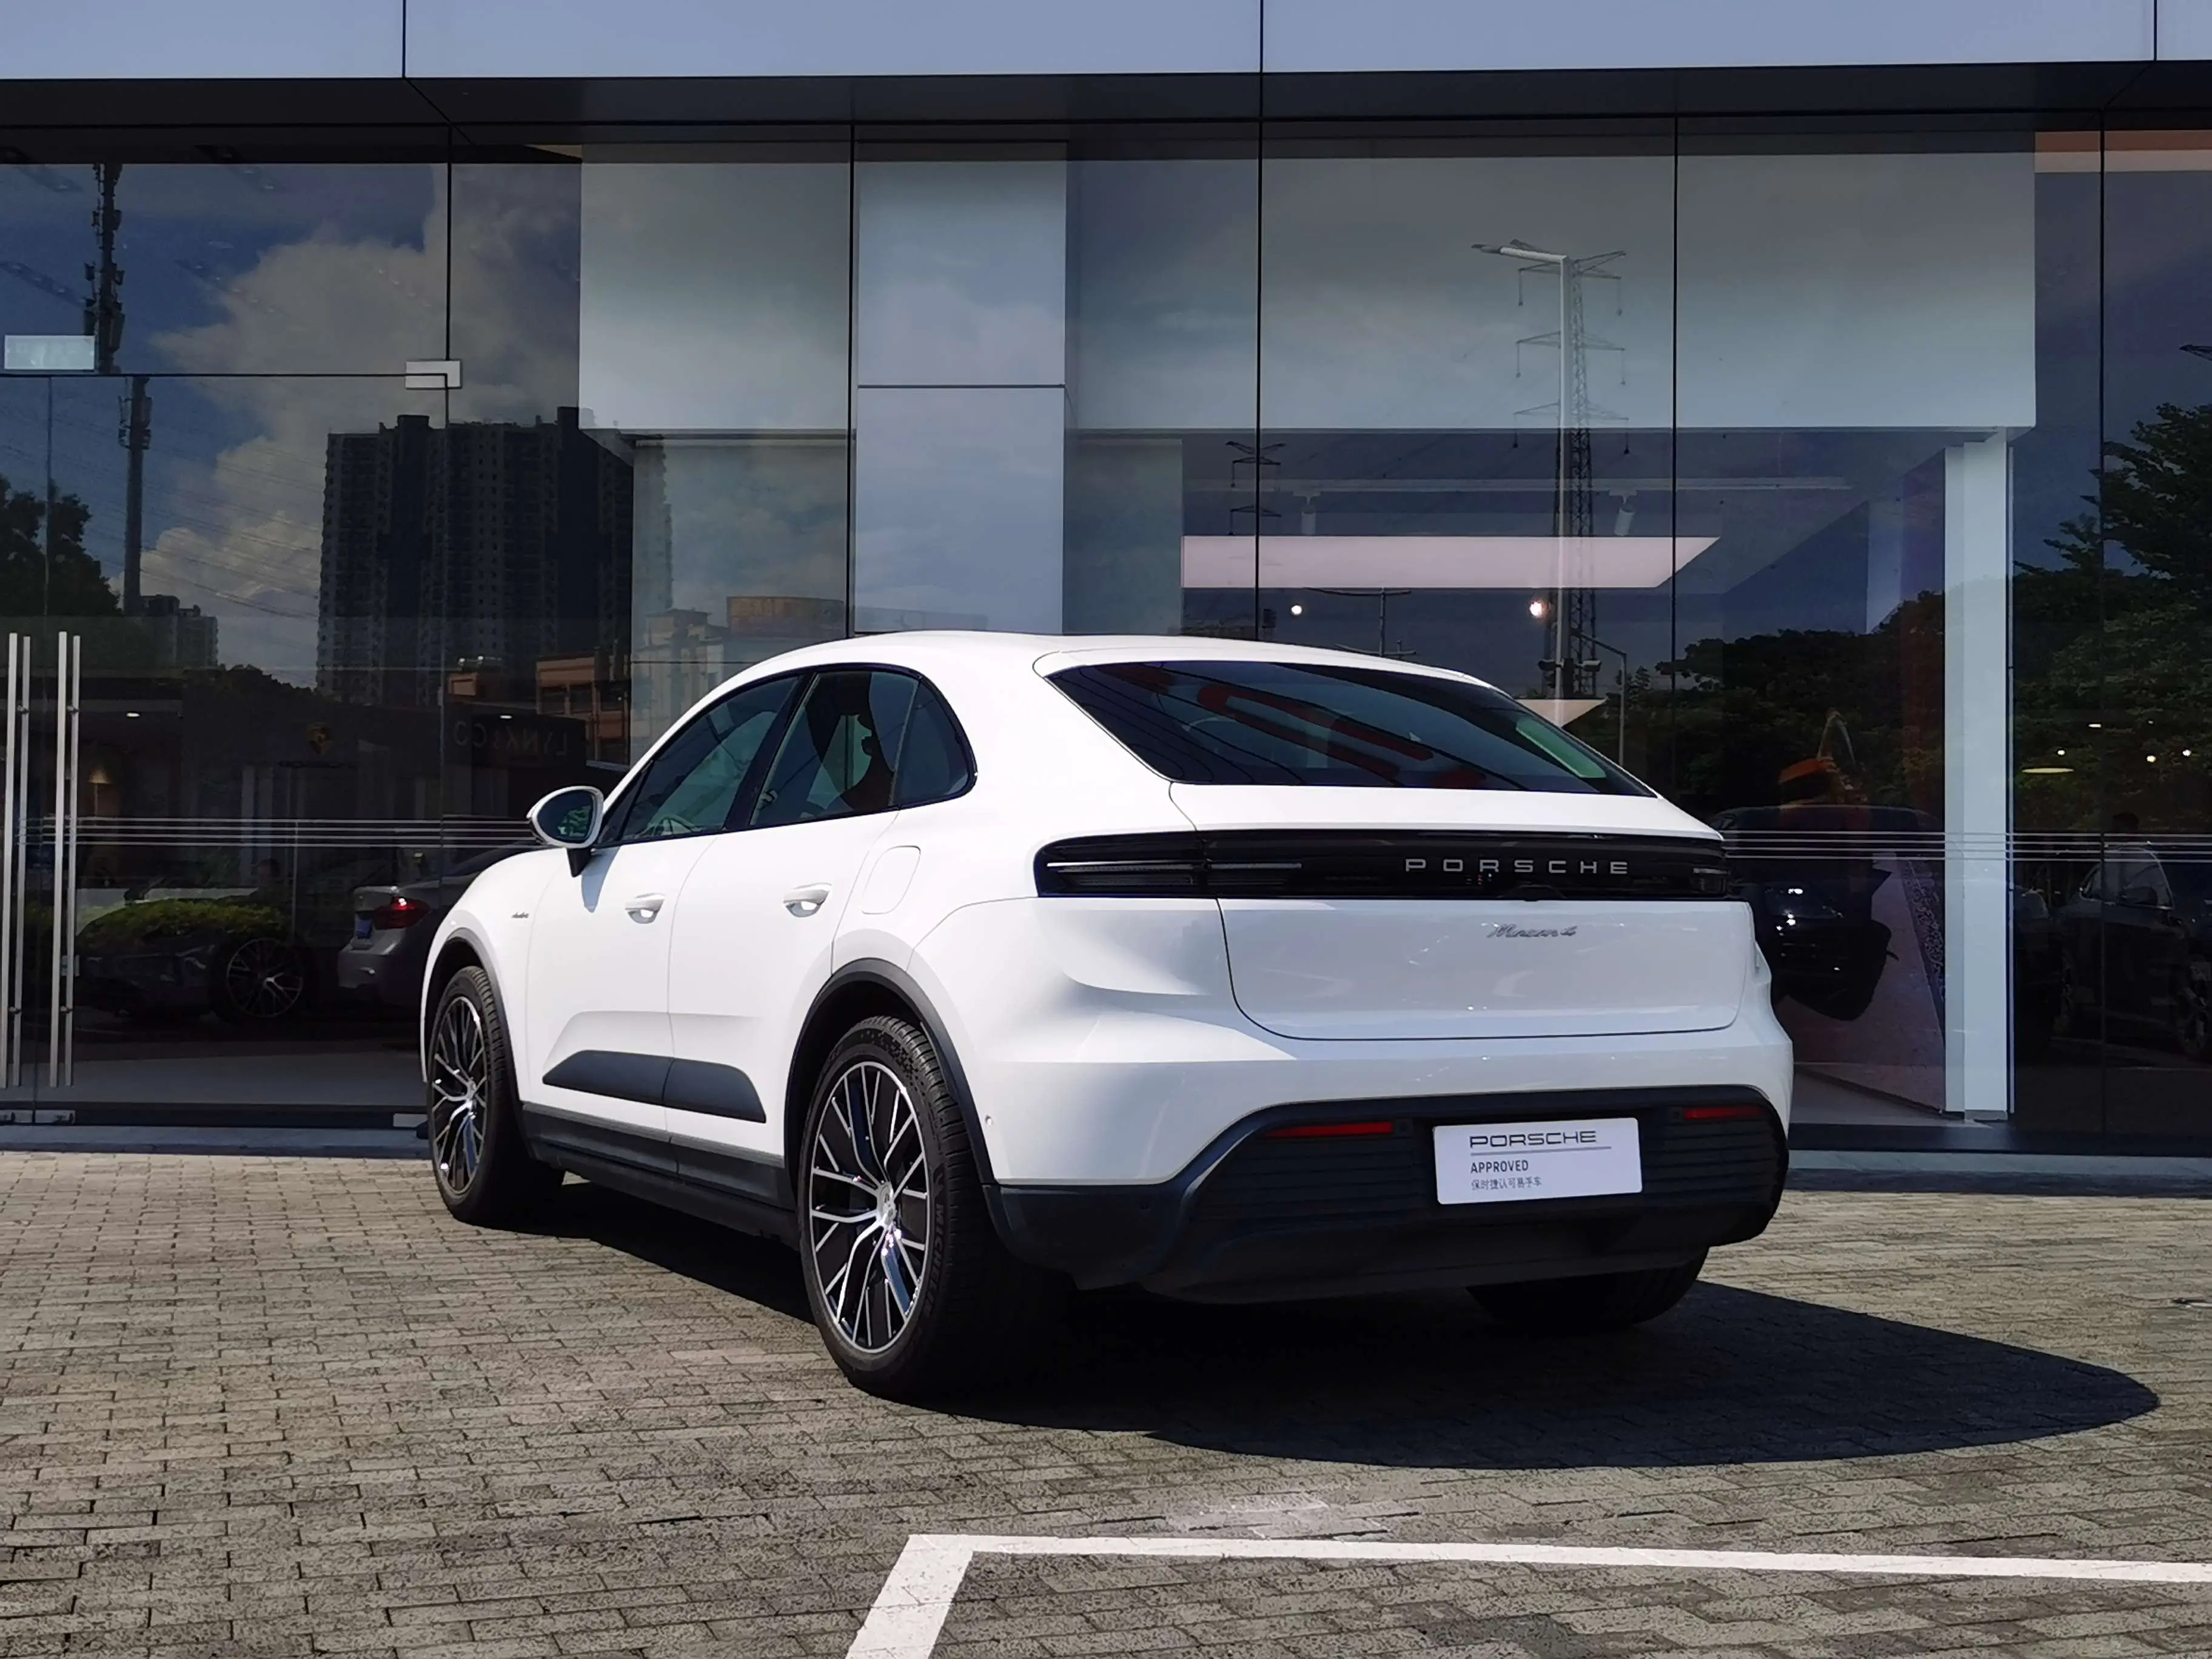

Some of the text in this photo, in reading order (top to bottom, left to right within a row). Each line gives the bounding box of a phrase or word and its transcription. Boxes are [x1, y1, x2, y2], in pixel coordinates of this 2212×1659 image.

[1405, 858, 1628, 874] PORSCHE
[1469, 1130, 1597, 1148] PORSCHE
[1470, 1159, 1529, 1174] APPROVED
